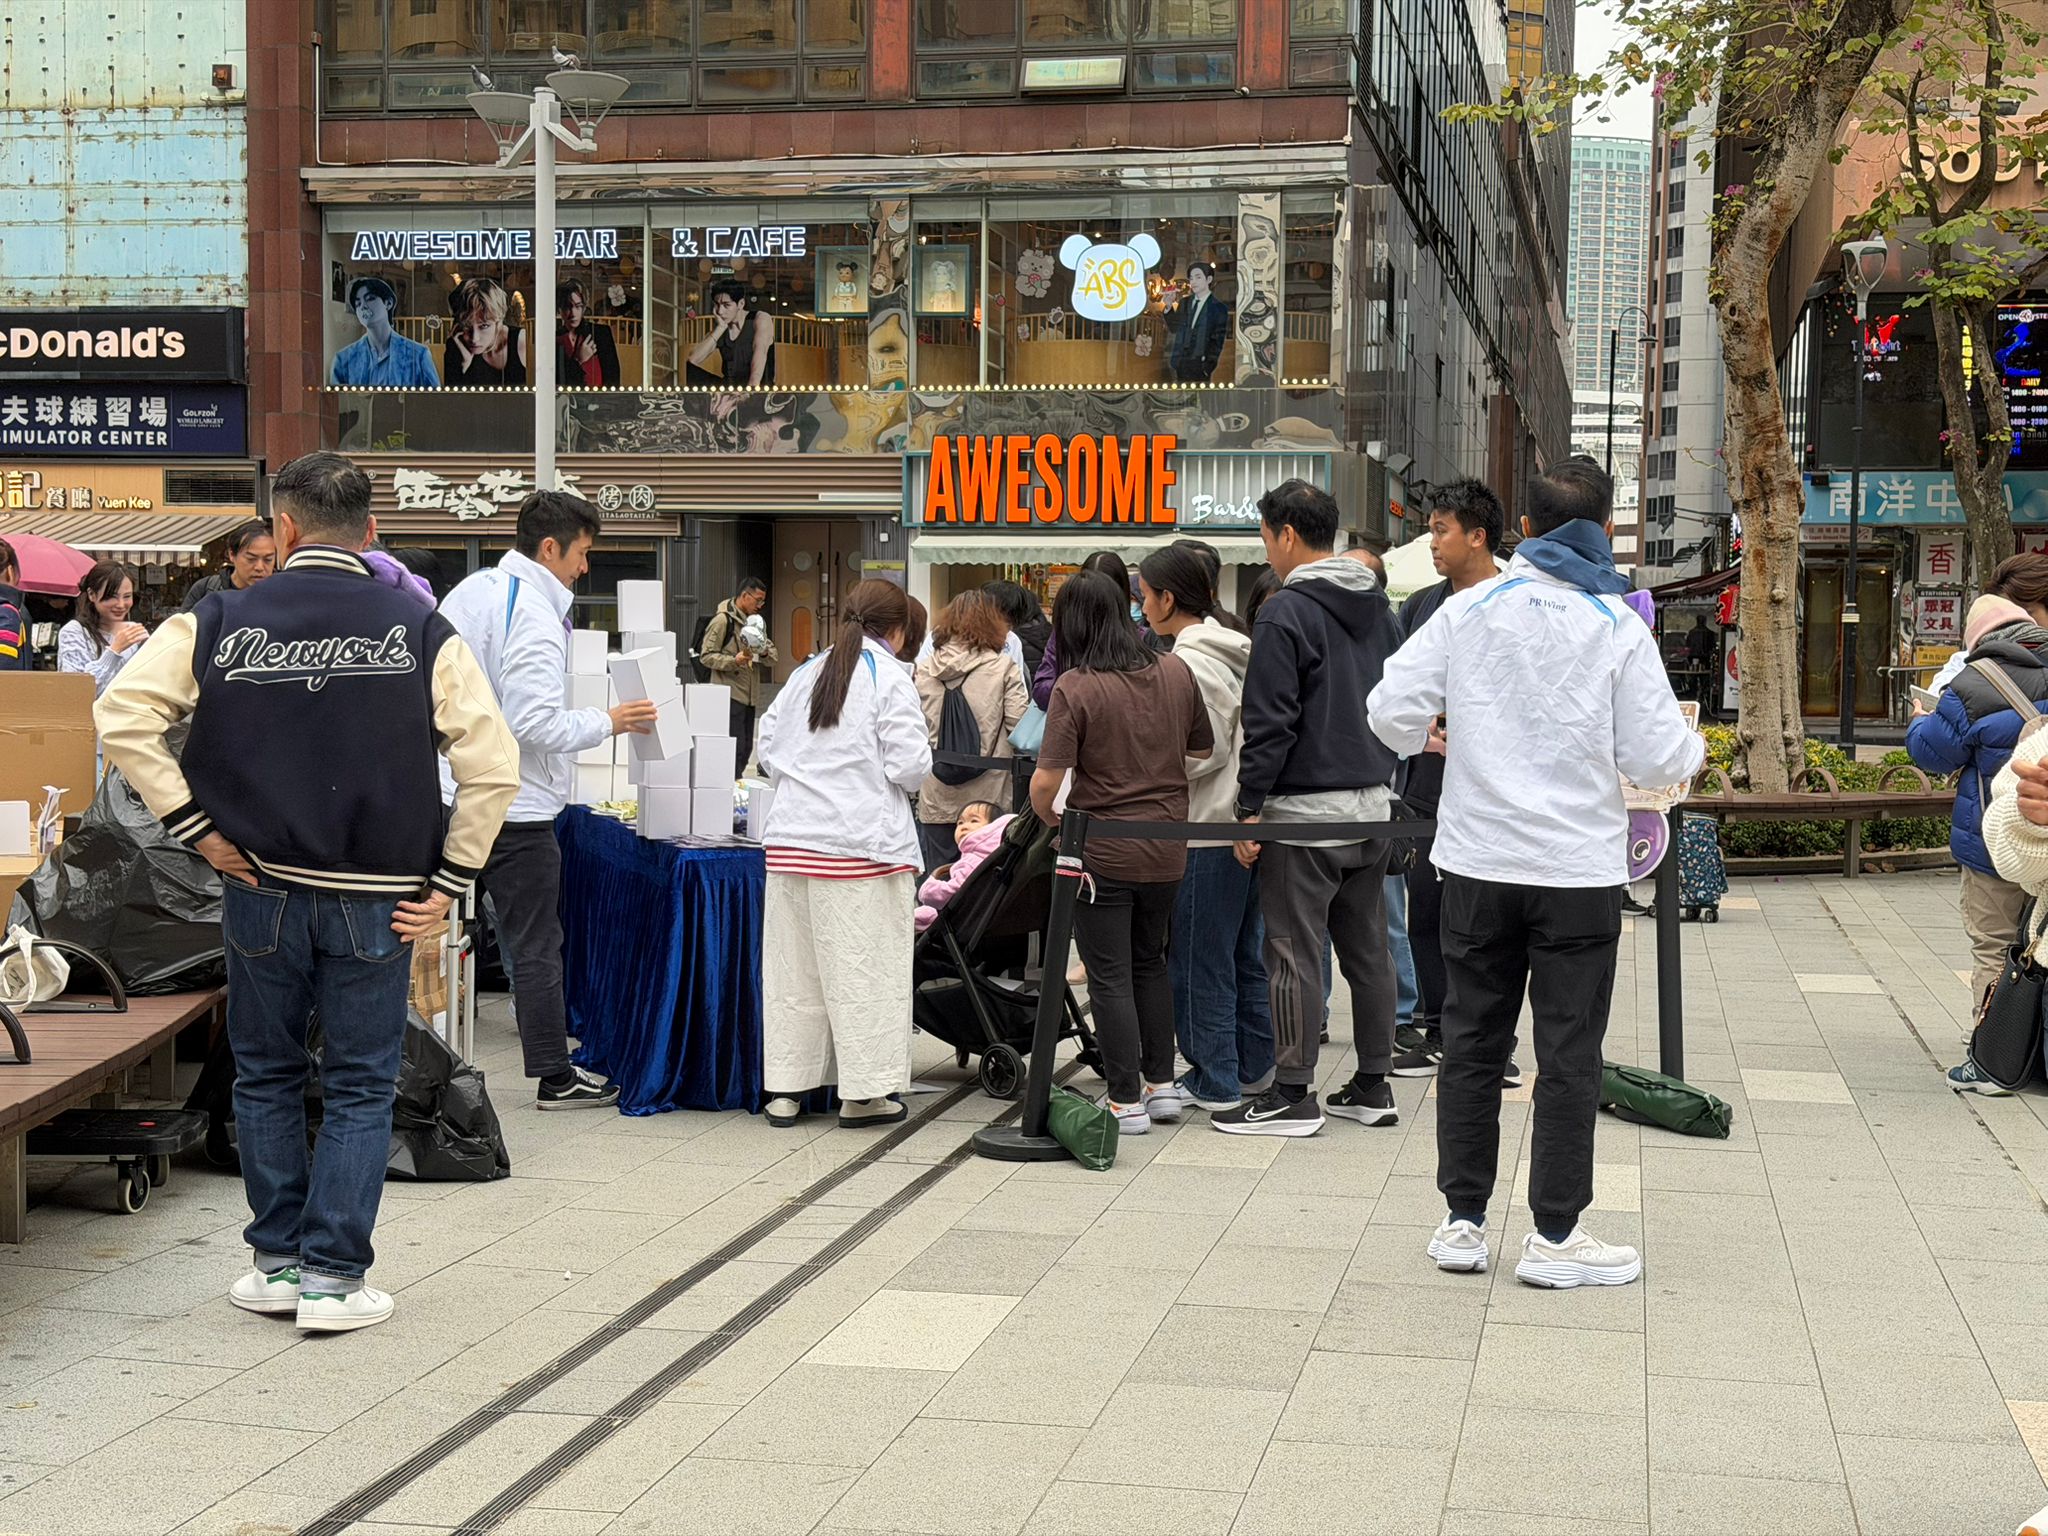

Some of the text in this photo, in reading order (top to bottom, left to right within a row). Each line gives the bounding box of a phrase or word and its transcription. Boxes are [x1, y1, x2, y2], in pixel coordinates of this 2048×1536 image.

[351, 230, 531, 260] AWESOME
[672, 228, 698, 257] &
[706, 227, 806, 257] CAFE
[1, 395, 167, 427] 夫球練習場
[0, 430, 168, 445] IMULATOR CENTER
[923, 433, 1177, 524] AWESOME
[97, 497, 126, 509] Yuen
[129, 496, 152, 509] Kee
[1828, 479, 2014, 517] 南洋中
[1927, 543, 1956, 575] 香
[1529, 598, 1566, 613] PR Wing
[1923, 617, 1954, 630] 文具
